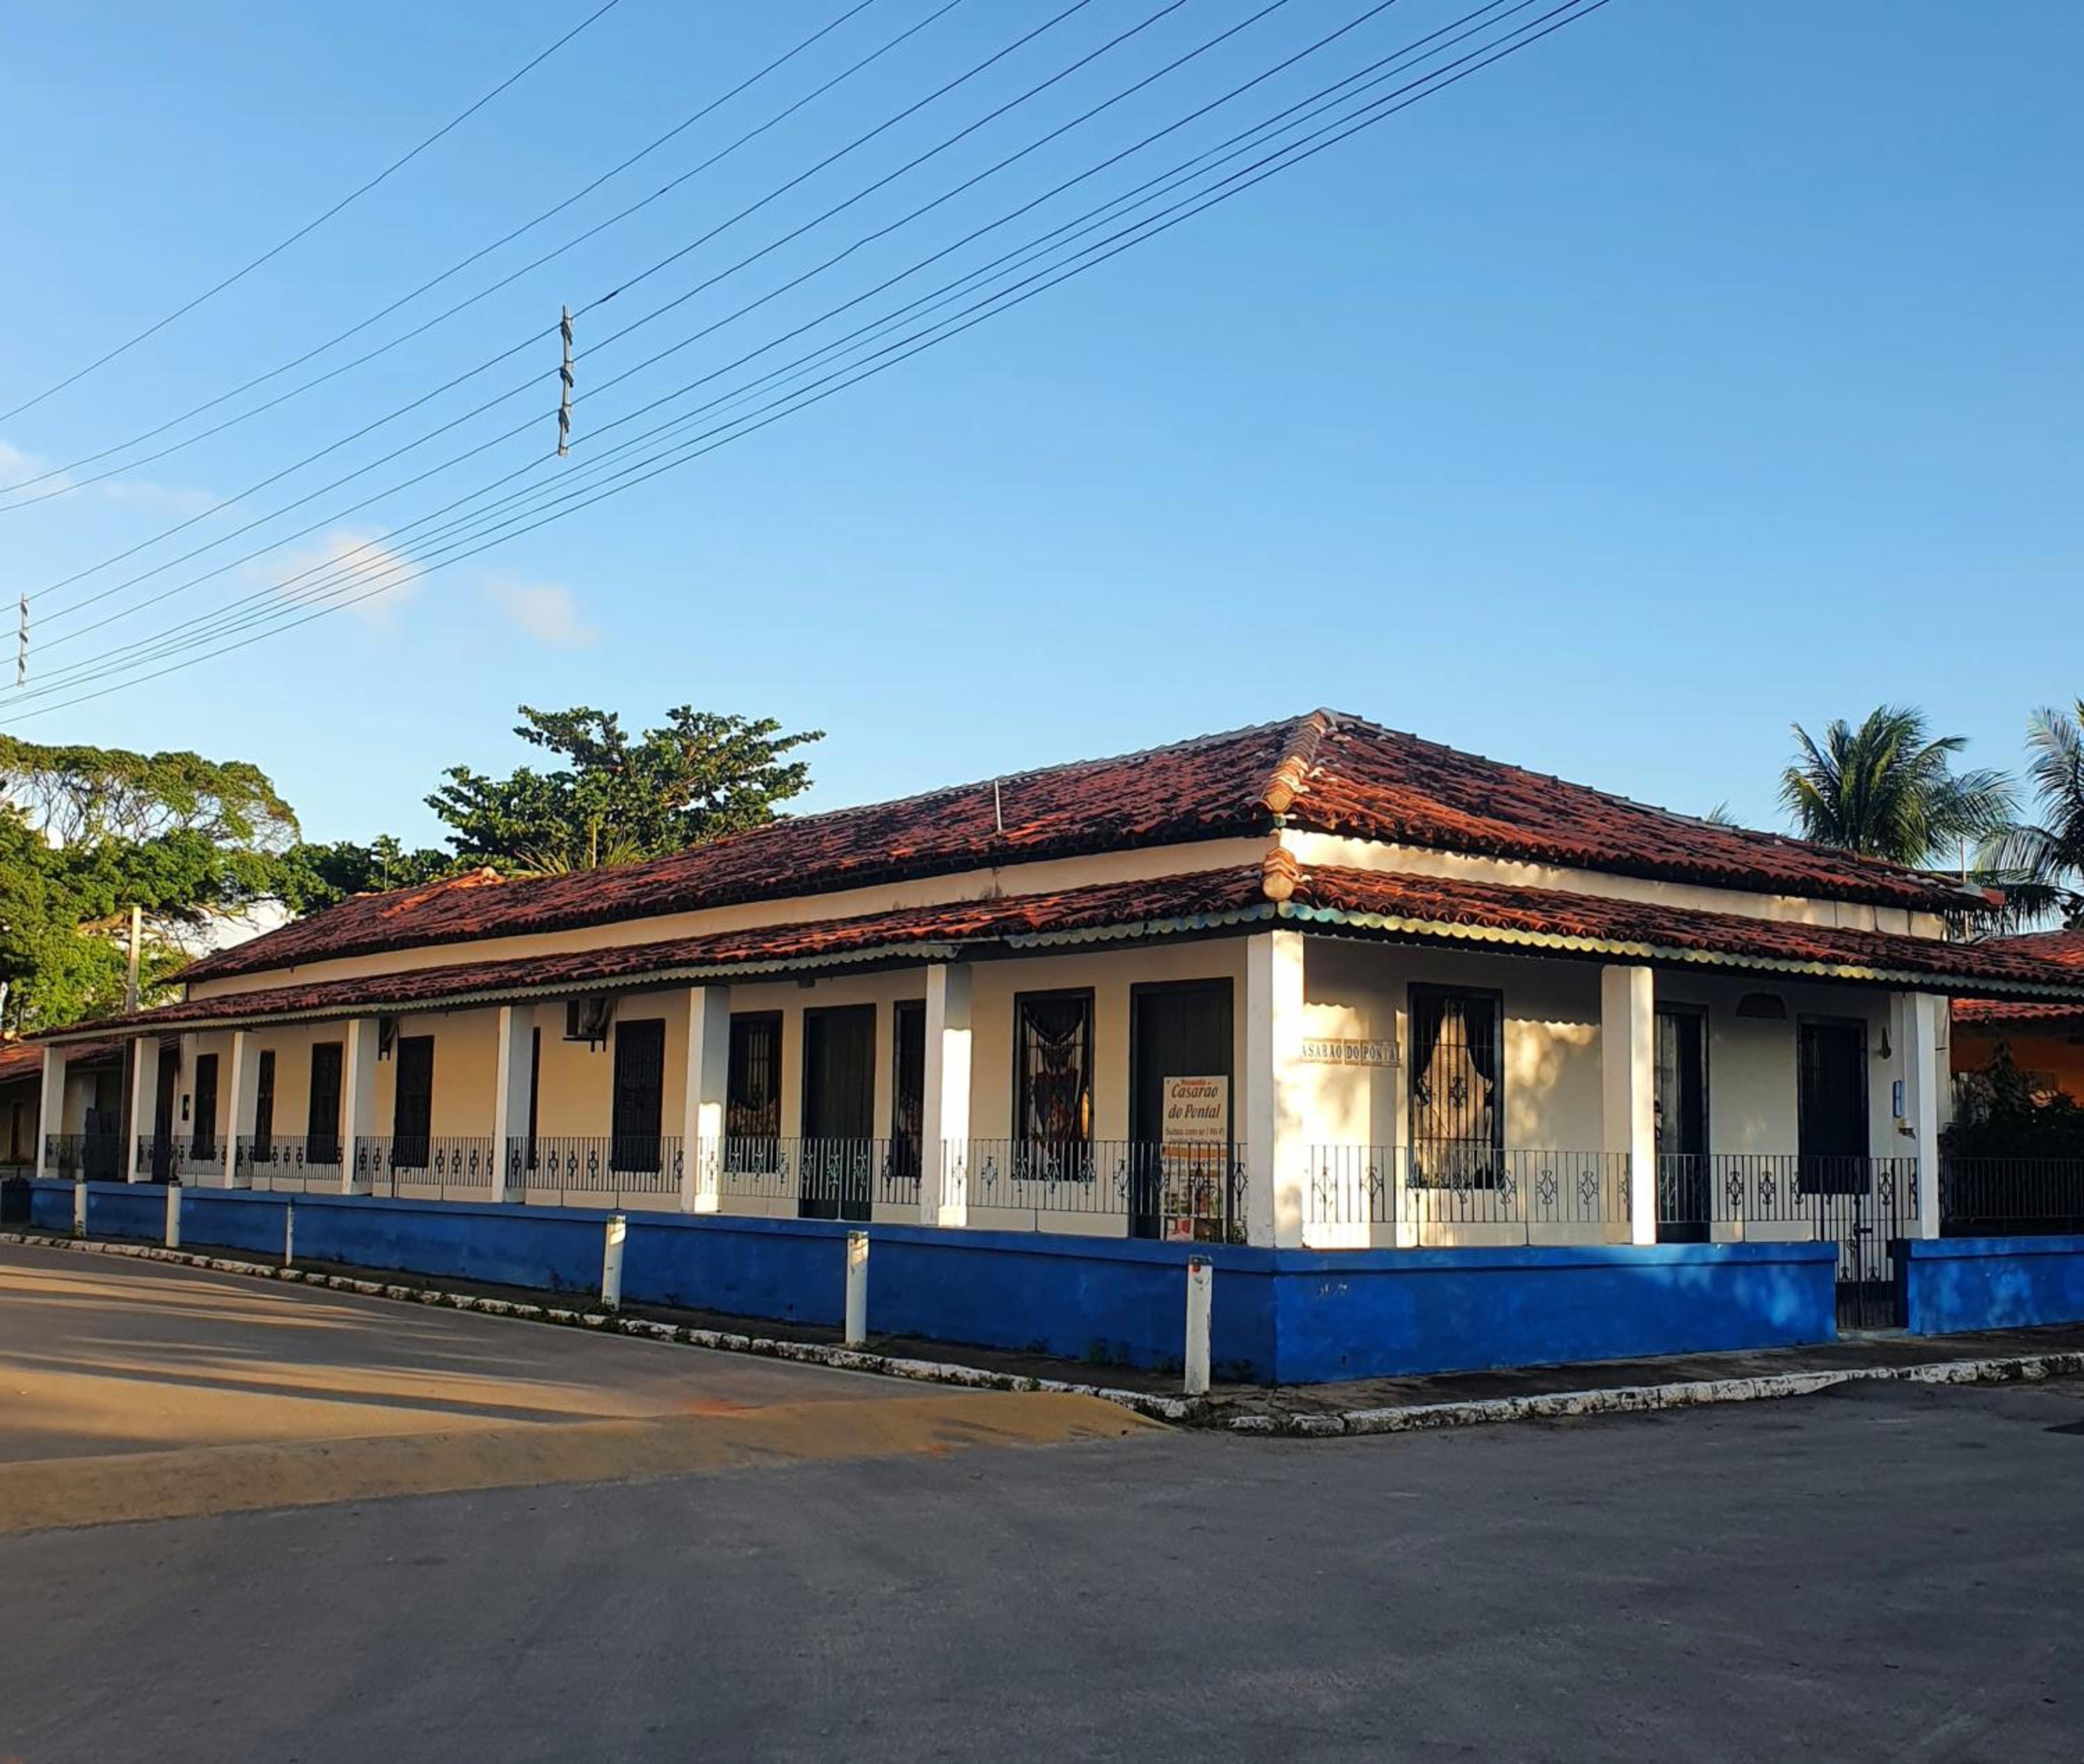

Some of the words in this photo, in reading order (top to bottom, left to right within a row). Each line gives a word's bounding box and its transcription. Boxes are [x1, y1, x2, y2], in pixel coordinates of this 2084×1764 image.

[1300, 1044, 1342, 1058] ASARÃO
[1347, 1045, 1359, 1059] DO
[1168, 1104, 1182, 1119] do
[1184, 1104, 1221, 1119] Pontal
